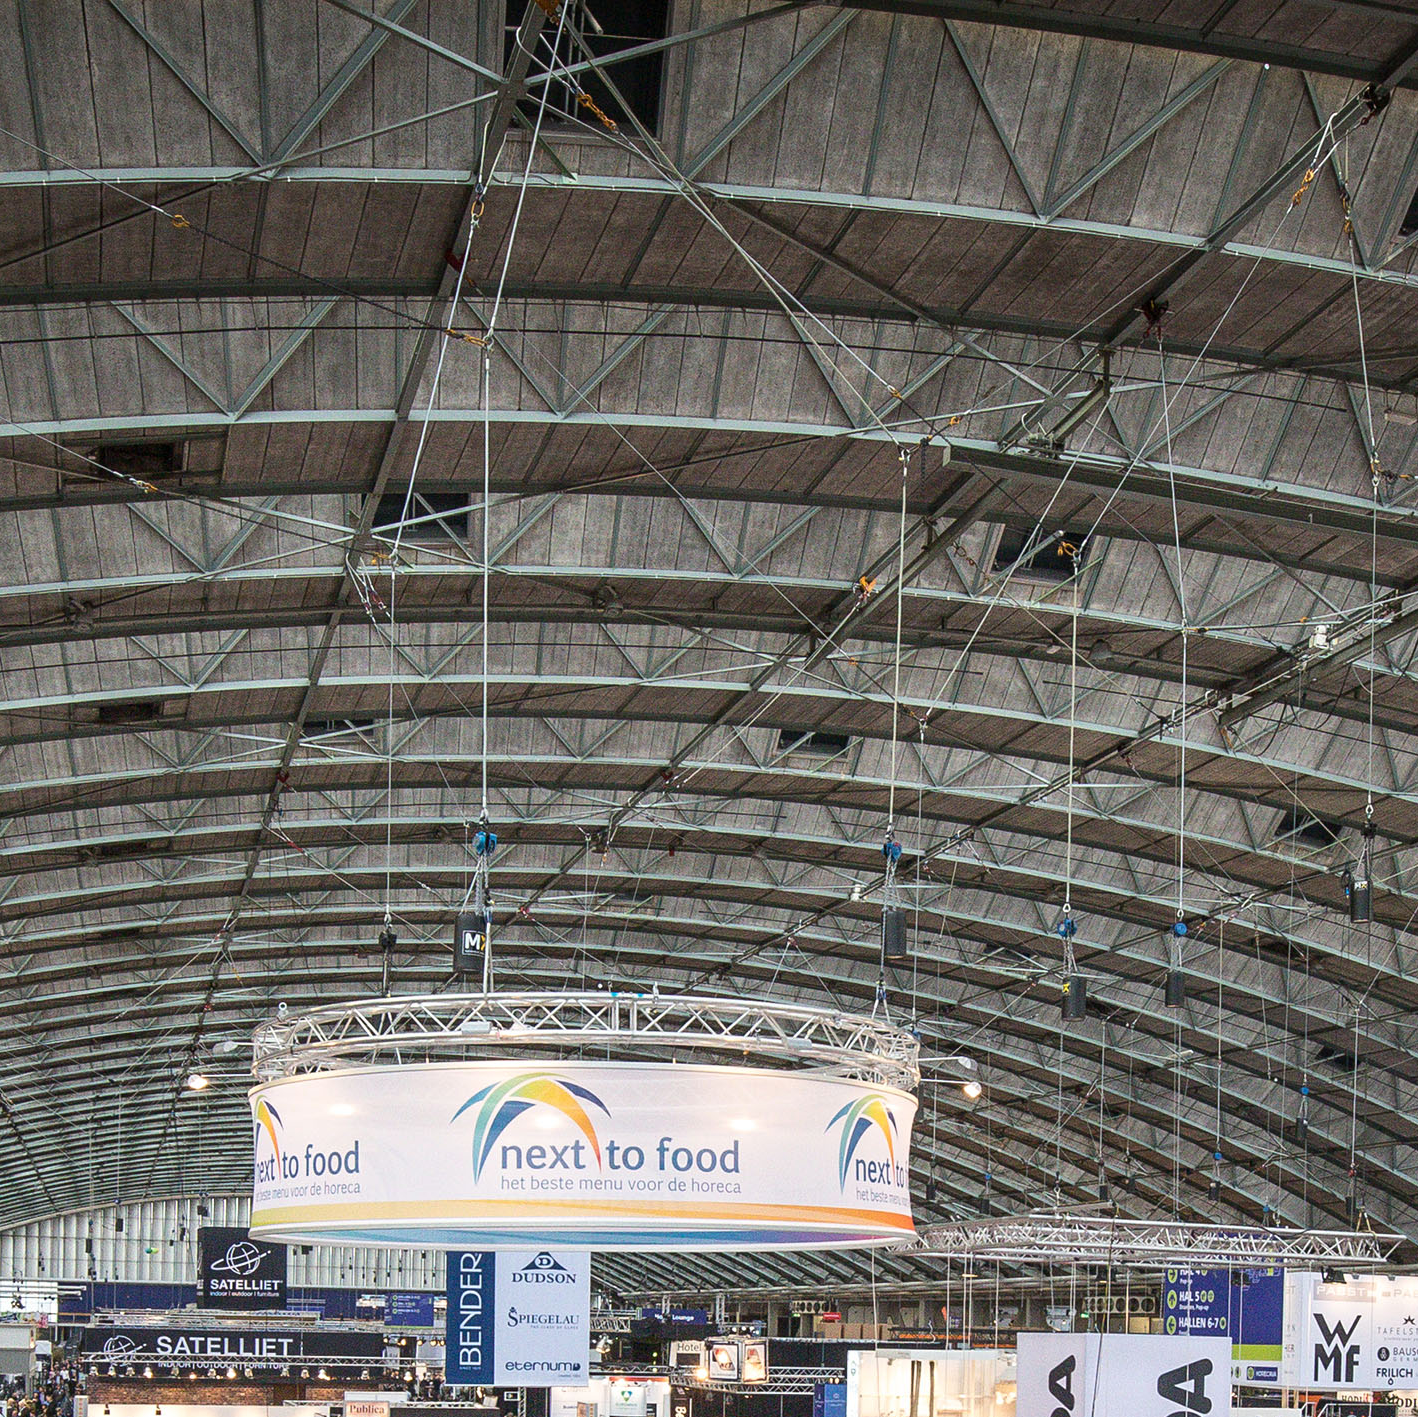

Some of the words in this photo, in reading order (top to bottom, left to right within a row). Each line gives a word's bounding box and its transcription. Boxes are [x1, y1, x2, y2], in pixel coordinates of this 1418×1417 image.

[282, 1152, 300, 1179] to
[305, 1140, 360, 1177] food
[501, 1140, 586, 1169] next
[607, 1144, 644, 1171] to
[656, 1136, 740, 1174] food
[856, 1154, 892, 1186] next
[290, 1186, 308, 1197] voor
[310, 1182, 321, 1196] de
[324, 1181, 360, 1194] horeca
[501, 1175, 525, 1191] het
[531, 1175, 574, 1191] beste
[579, 1178, 623, 1191] menu
[628, 1179, 665, 1192] voor
[668, 1176, 687, 1192] de
[691, 1178, 741, 1194] horeca
[856, 1187, 868, 1199] het
[210, 1279, 280, 1290] SATELLIET
[512, 1273, 577, 1284] DUDSON
[1179, 1291, 1194, 1301] HAL
[1195, 1291, 1200, 1301] 5
[459, 1252, 483, 1366] BENDER
[507, 1310, 579, 1328] SPIEGELAU
[1178, 1317, 1206, 1328] HALLEN
[1207, 1317, 1219, 1328] 6-7
[156, 1336, 293, 1356] SATELLIET
[677, 1342, 702, 1352] Hotel
[1313, 1313, 1362, 1383] WMF
[505, 1361, 572, 1371] eternum
[1376, 1367, 1413, 1378] FRILICH
[349, 1404, 386, 1416] Publica
